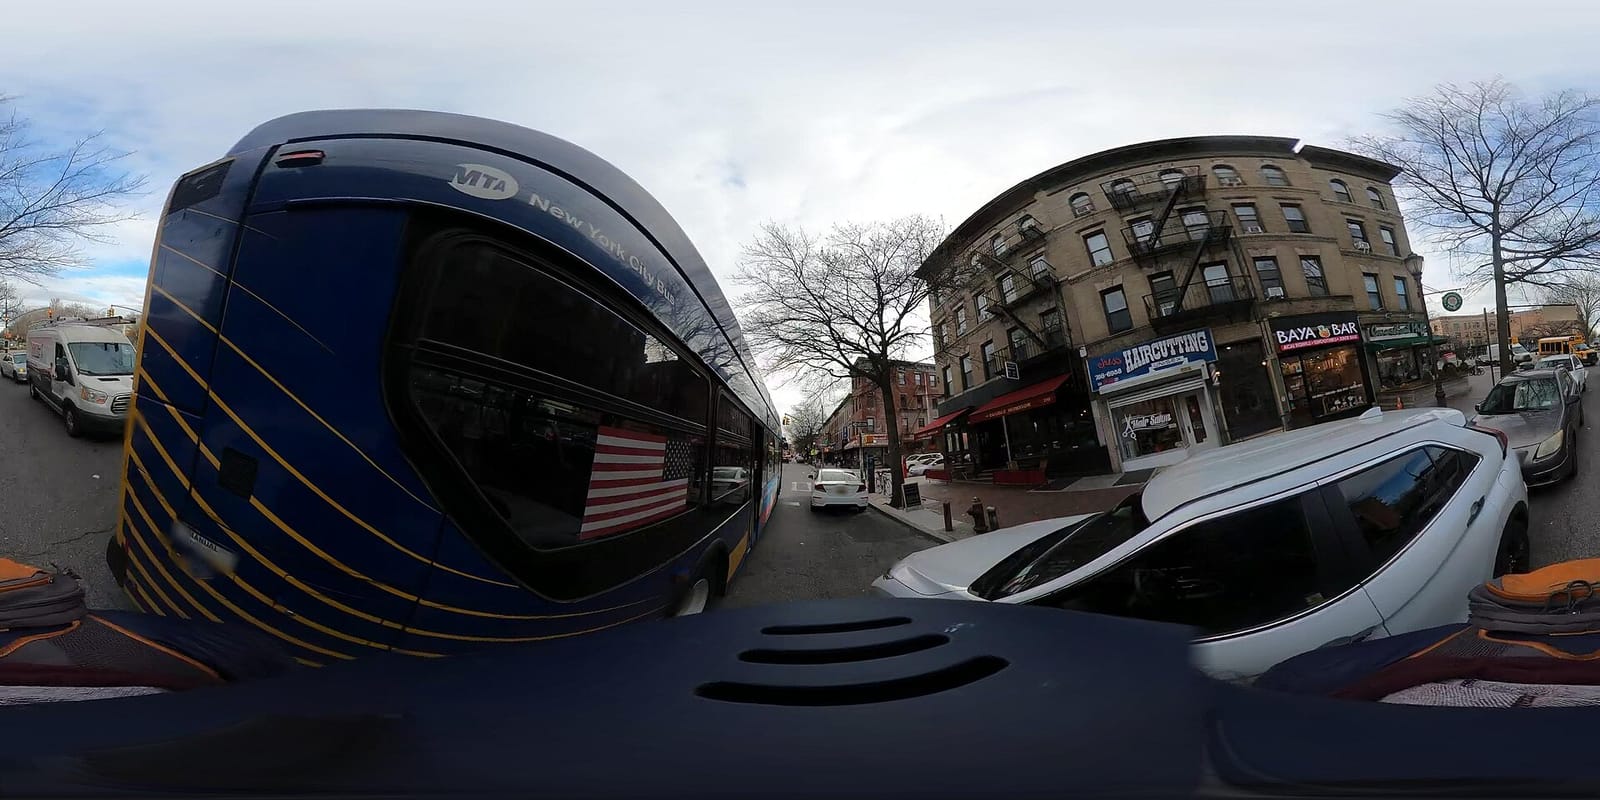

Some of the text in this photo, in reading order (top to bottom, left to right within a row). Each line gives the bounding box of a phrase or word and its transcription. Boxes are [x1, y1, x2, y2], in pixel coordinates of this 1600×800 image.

[454, 166, 507, 193] MTA
[528, 193, 676, 305] New York City Bus
[1276, 326, 1317, 344] BAYA
[1331, 322, 1358, 336] BAR
[1122, 331, 1209, 374] HAIRCUTTING
[1131, 416, 1149, 429] Hair
